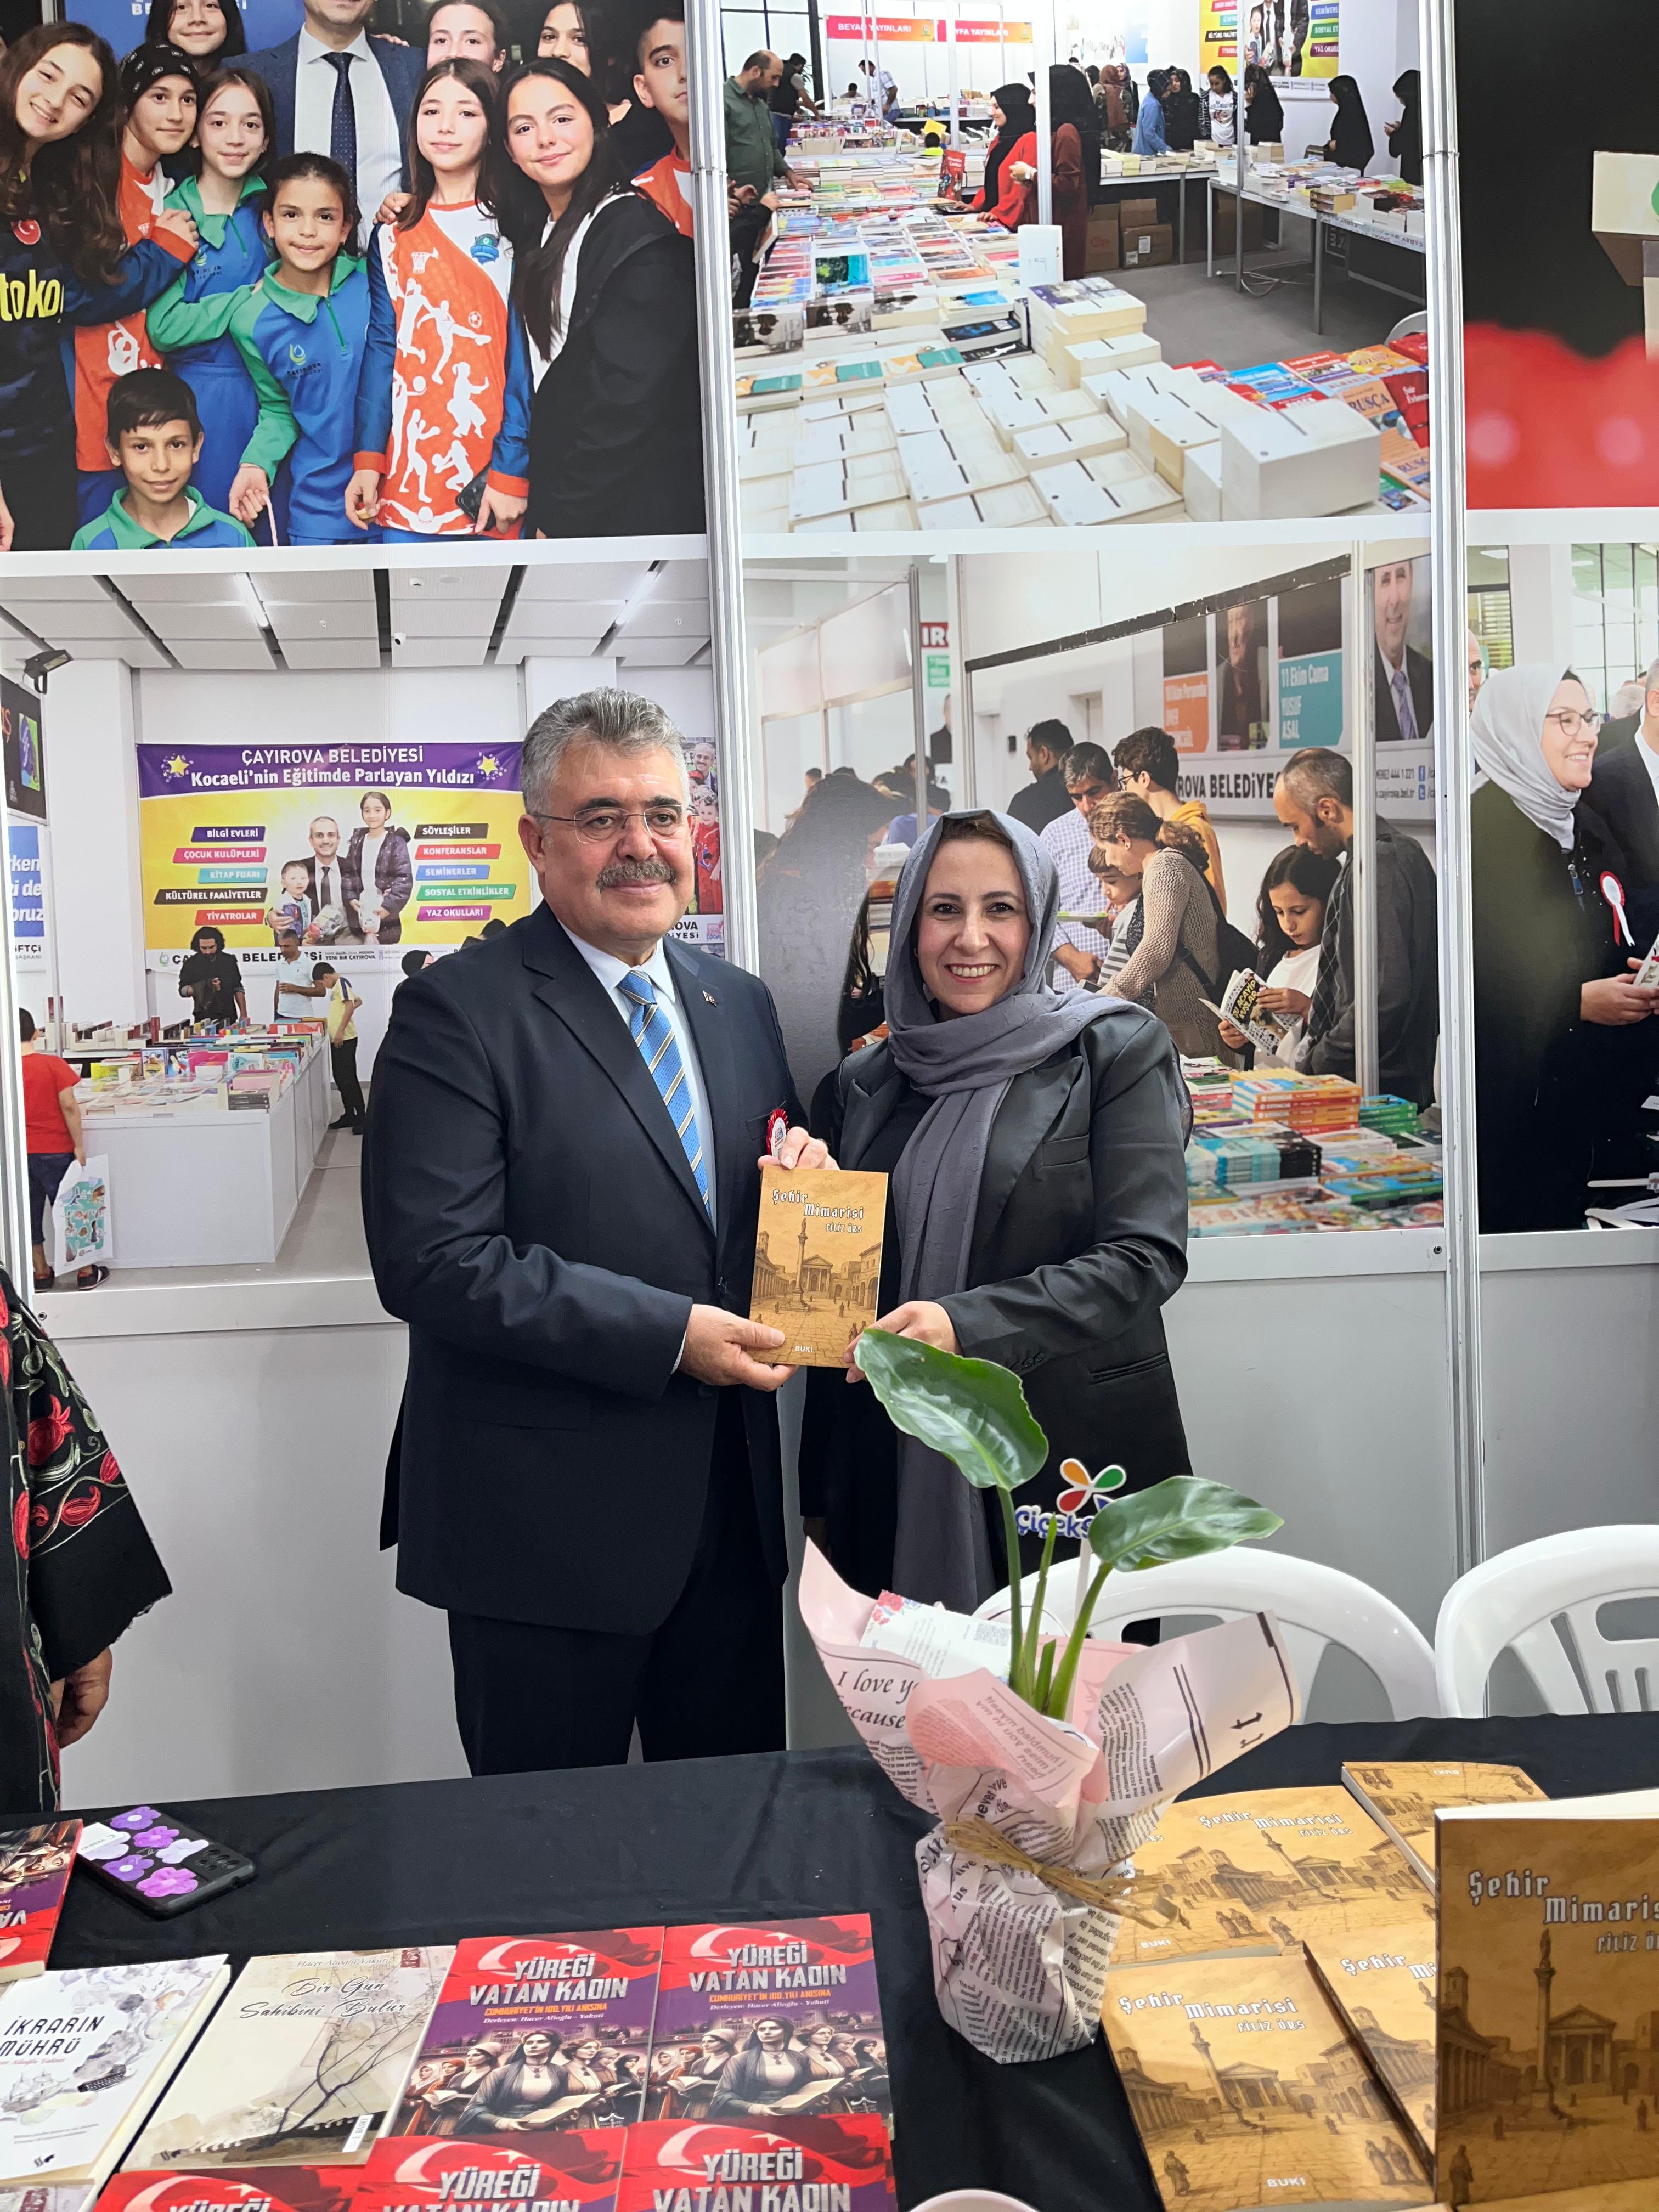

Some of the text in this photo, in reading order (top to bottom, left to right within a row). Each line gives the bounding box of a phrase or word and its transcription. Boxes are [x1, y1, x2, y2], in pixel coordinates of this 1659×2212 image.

[0, 269, 64, 323] toko
[1290, 666, 1307, 687] Ekim
[1308, 663, 1329, 684] Cuma
[1282, 695, 1302, 716] YUSUF
[1281, 719, 1300, 740] ASAL
[242, 744, 424, 766] ÇAYIROVA BELEDİYESİ
[191, 768, 475, 787] Kocaeli'nin Eğitimde Parlayan Yıldızı
[1177, 771, 1280, 799] ROVA BELEDİYE
[207, 828, 258, 838] BİLGİ EVLERİ
[422, 825, 471, 836] SÖYLEŞİLER
[184, 850, 259, 860] ÇOCUK KULÜPLERİ
[424, 847, 487, 855] KONFERANSLAR
[210, 869, 234, 878] KİTAP
[425, 866, 477, 876] SEMİNERLER
[165, 890, 261, 900] KÜLTÜREL FAALİYETLER
[425, 886, 509, 896] SOSYAL ETKİNLİKLER
[206, 911, 257, 920] TİYATROLAR
[443, 909, 483, 917] OKULLARI
[673, 922, 698, 930] OVA
[772, 1189, 808, 1205] Şehir
[804, 1203, 864, 1220] Mimarisi
[826, 1222, 862, 1234] FİLİZ ÖRS
[835, 1671, 849, 1687] I
[853, 1669, 894, 1693] love
[1198, 1810, 1251, 1829] Şehir
[1252, 1813, 1345, 1830] Mimarisi
[1147, 1833, 1164, 1843] RS
[1298, 1826, 1354, 1837] FİLİZ ÖRS
[953, 1886, 968, 1901] us
[1468, 1869, 1551, 1908] Şehir
[0, 1910, 27, 1929] VA
[1596, 1929, 1659, 1954] FİLİZ Ö
[726, 1940, 808, 1968] YÜREĞİ
[514, 1953, 596, 1982] YÜREĞİ
[1340, 1952, 1407, 1977] Şehir
[281, 1975, 387, 2000] Bir Gün
[688, 1964, 847, 1993] VATAN KADIN
[470, 1977, 629, 2006] VATAN KADIN
[800, 1989, 832, 1997] ANISINA
[239, 1997, 409, 2019] Sahibini Bulur
[575, 2002, 608, 2012] ANISINA
[1117, 1990, 1184, 2016] Şehir
[1182, 1997, 1299, 2020] Mimarisi
[4, 2015, 106, 2036] İKRARIN
[1237, 2018, 1306, 2033] FİLİZ ÖRS
[0, 2036, 82, 2058] MÜHRÜ
[702, 2145, 804, 2183] YÜREĞİ
[438, 2164, 541, 2202] YÜREĞİ
[653, 2182, 850, 2212] VATAN KADIN
